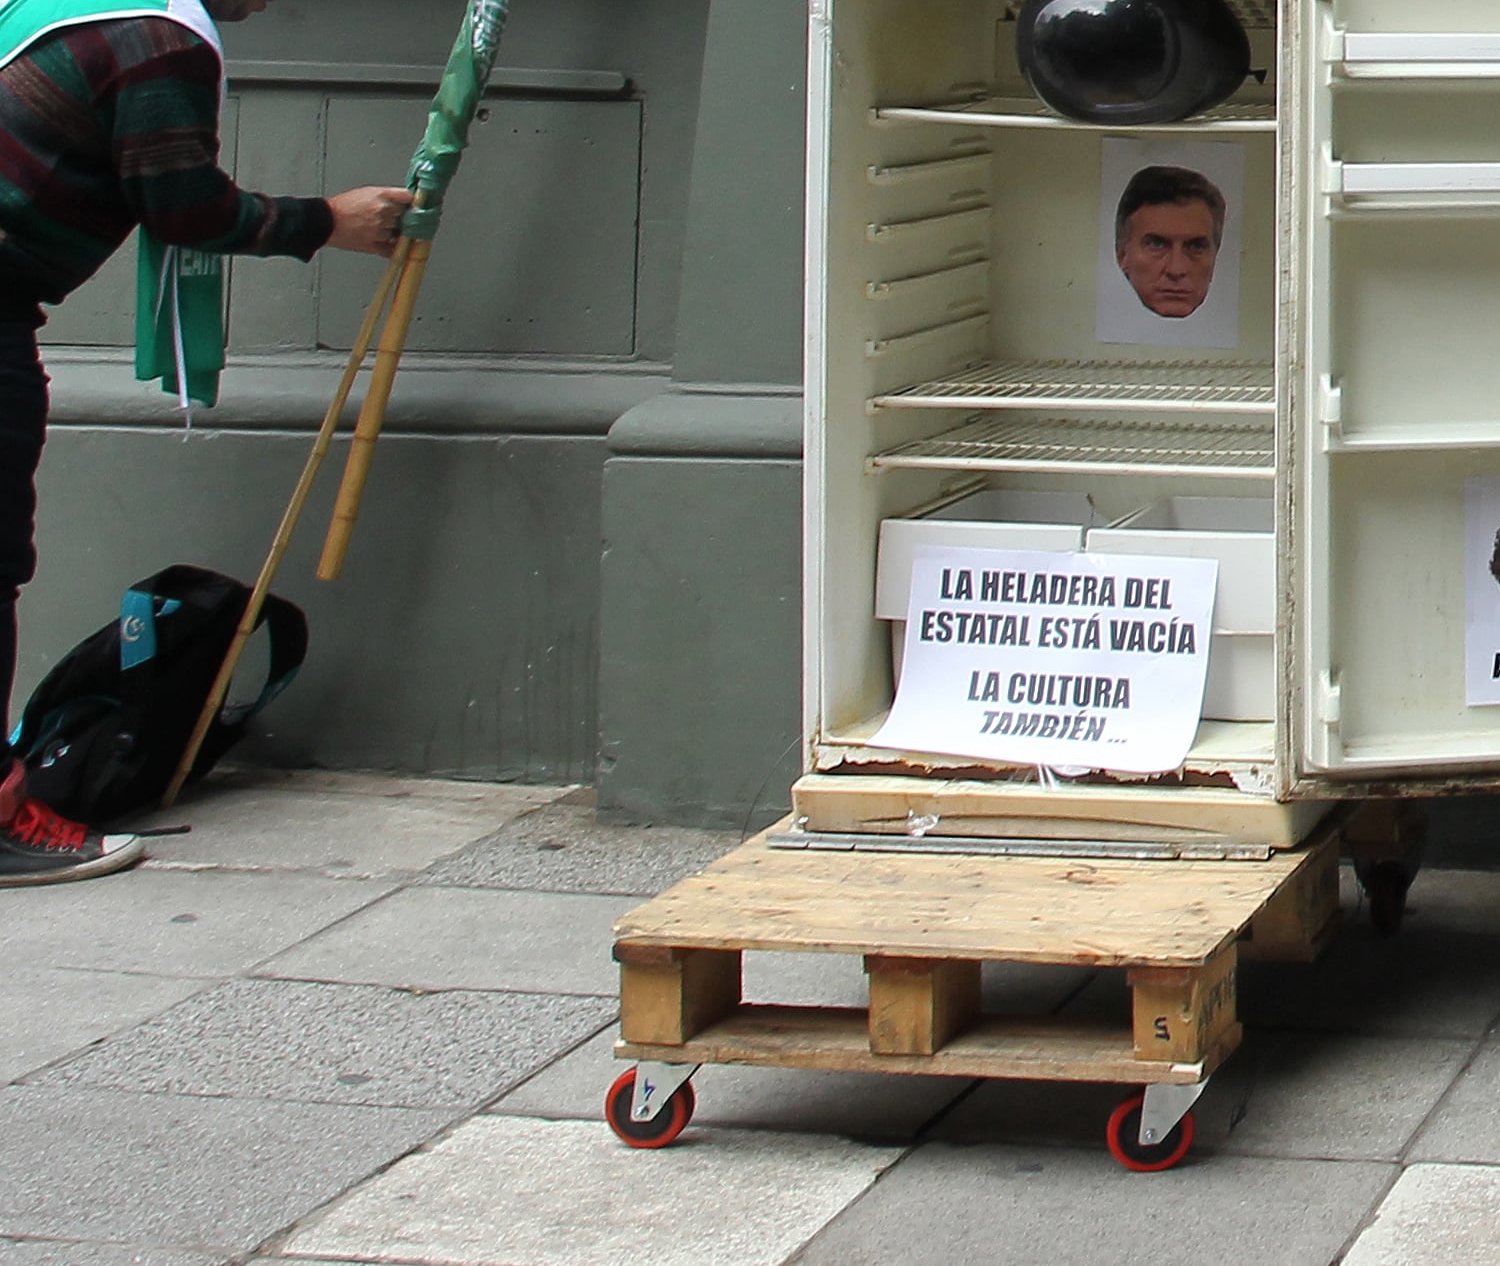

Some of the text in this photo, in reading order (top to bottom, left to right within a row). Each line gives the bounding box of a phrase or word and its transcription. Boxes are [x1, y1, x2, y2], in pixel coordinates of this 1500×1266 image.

[941, 568, 1172, 610] LA HELADERA DEL
[920, 611, 1197, 655] ESTATAL ESTÁ VACÍA
[967, 670, 1131, 710] LA CULTURA
